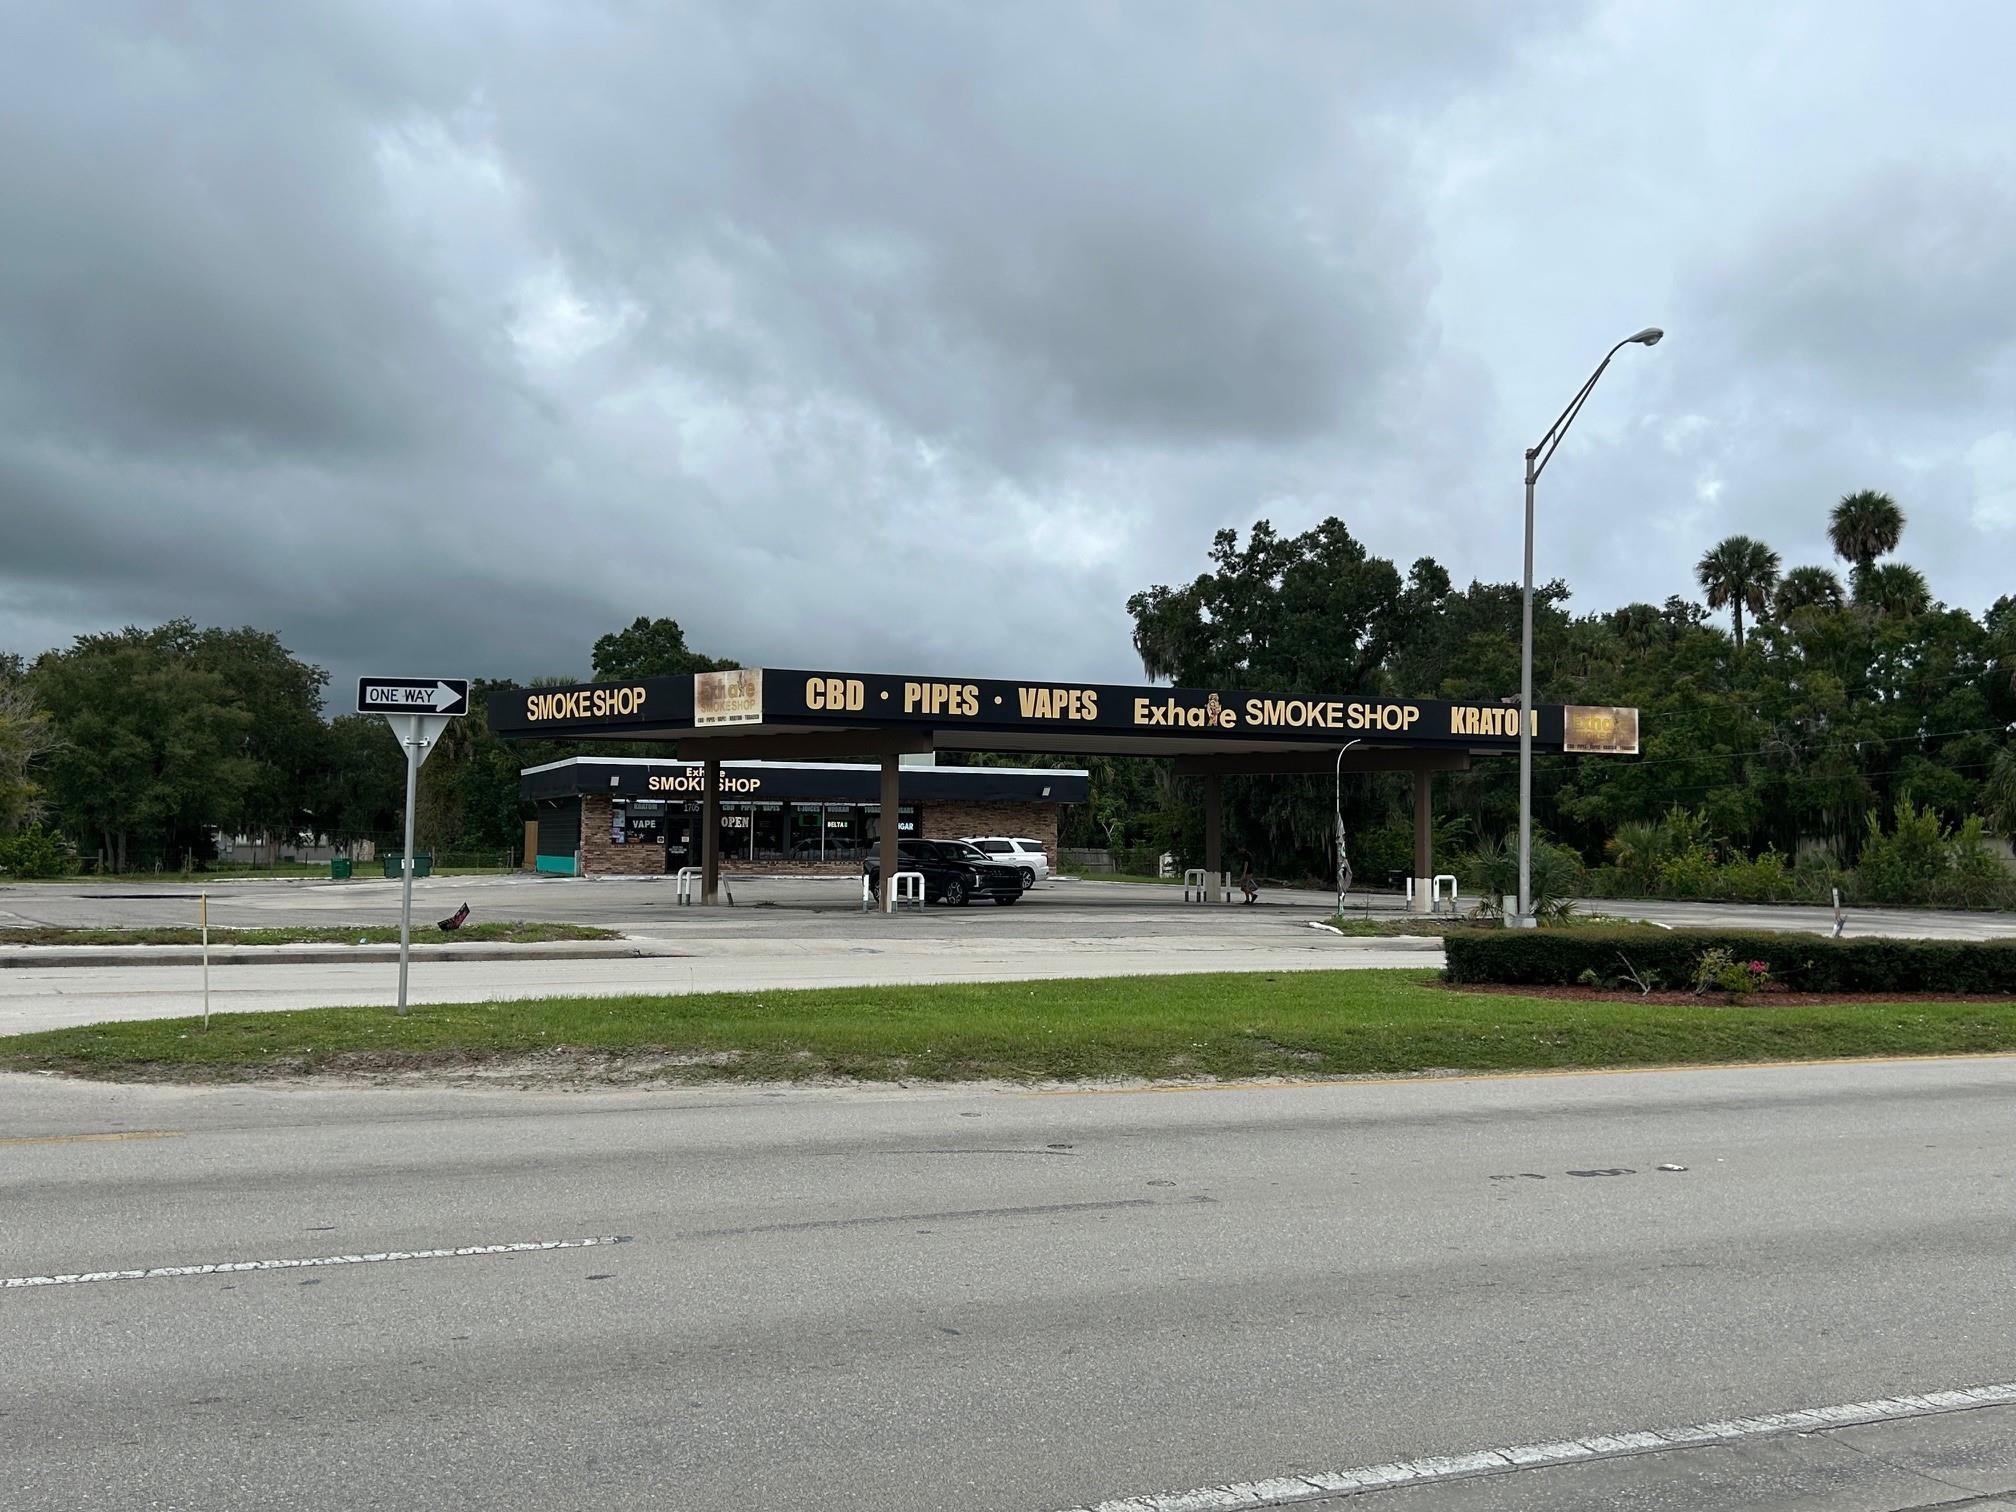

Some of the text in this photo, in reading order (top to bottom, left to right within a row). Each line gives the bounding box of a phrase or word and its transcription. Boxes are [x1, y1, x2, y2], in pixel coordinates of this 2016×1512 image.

[370, 688, 435, 703] ONE WAY
[806, 677, 1098, 721] CBD PIPES VAPES
[527, 687, 646, 721] SMOKE SHOP
[1245, 699, 1344, 728] SMOKE
[1347, 703, 1420, 731] SHOP
[686, 767, 726, 778] Exhe
[632, 820, 656, 828] VAPE
[721, 816, 750, 828] OPEN
